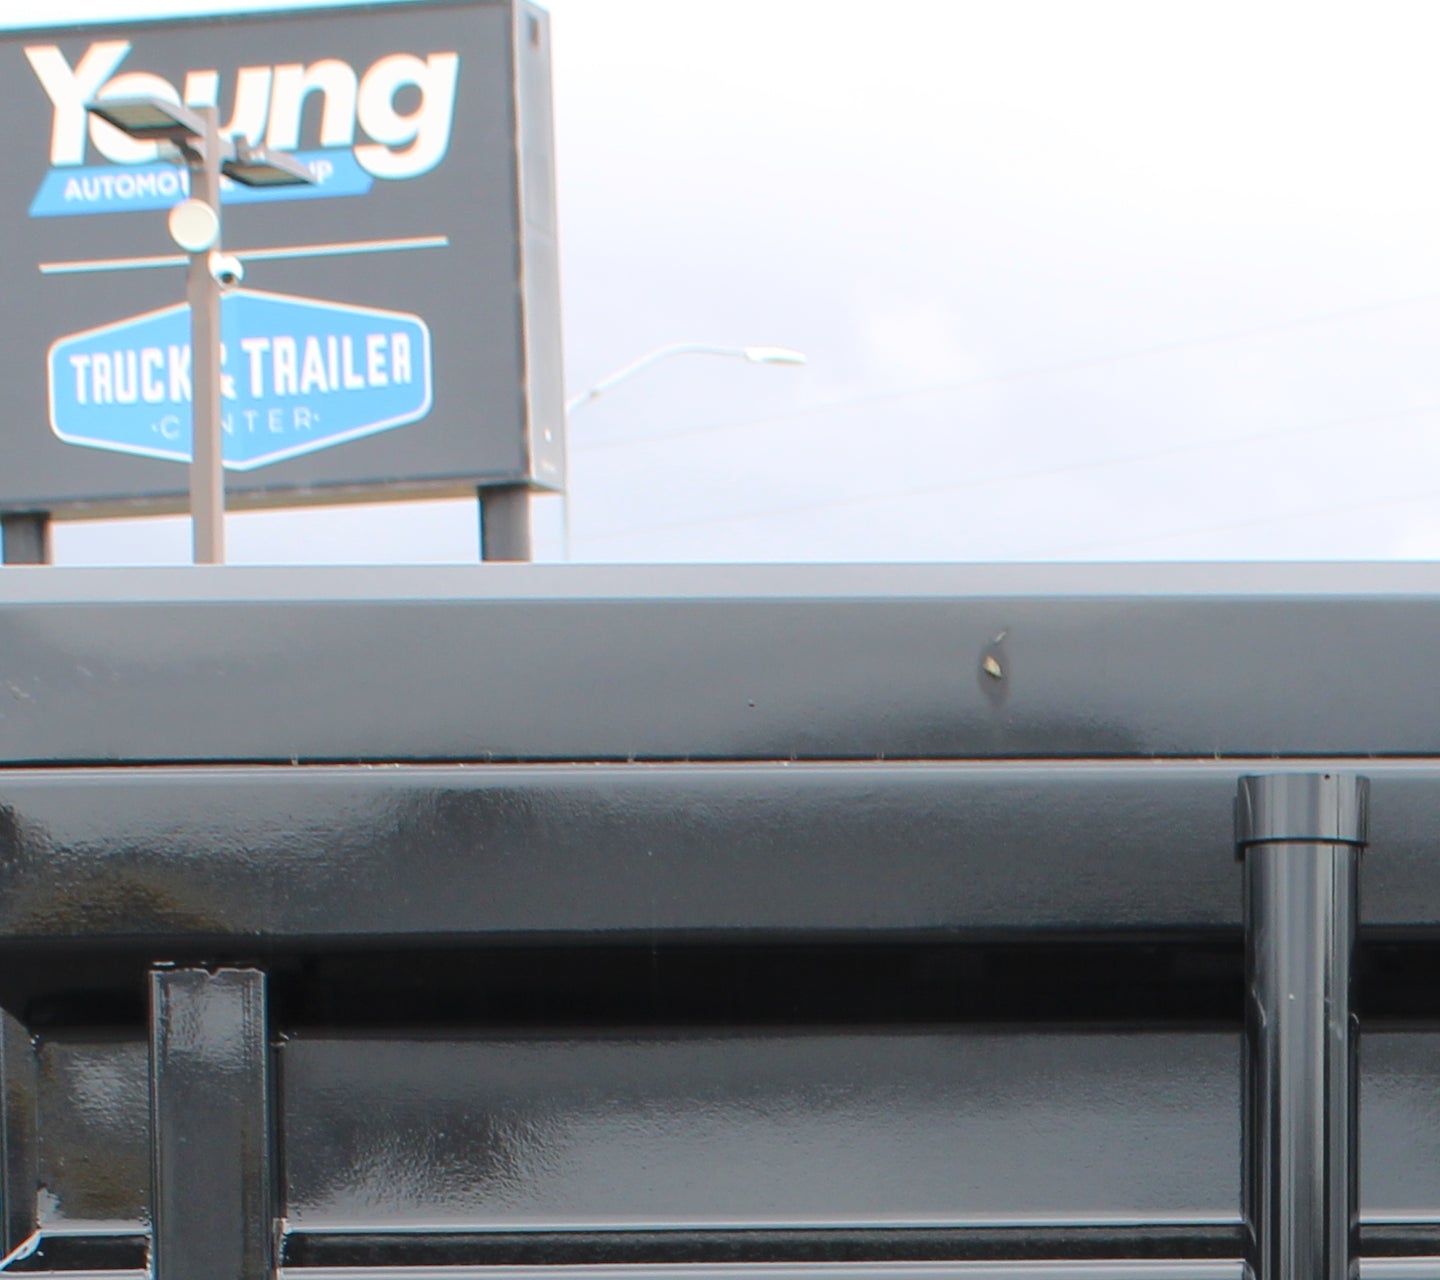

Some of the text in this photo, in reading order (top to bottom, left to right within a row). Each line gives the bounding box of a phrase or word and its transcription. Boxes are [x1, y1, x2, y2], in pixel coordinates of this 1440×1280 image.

[24, 40, 458, 180] Young
[64, 168, 234, 202] AUTOMO
[69, 344, 192, 406] TRUCK
[241, 332, 413, 399] TRAILER
[157, 406, 315, 440] CNTER
